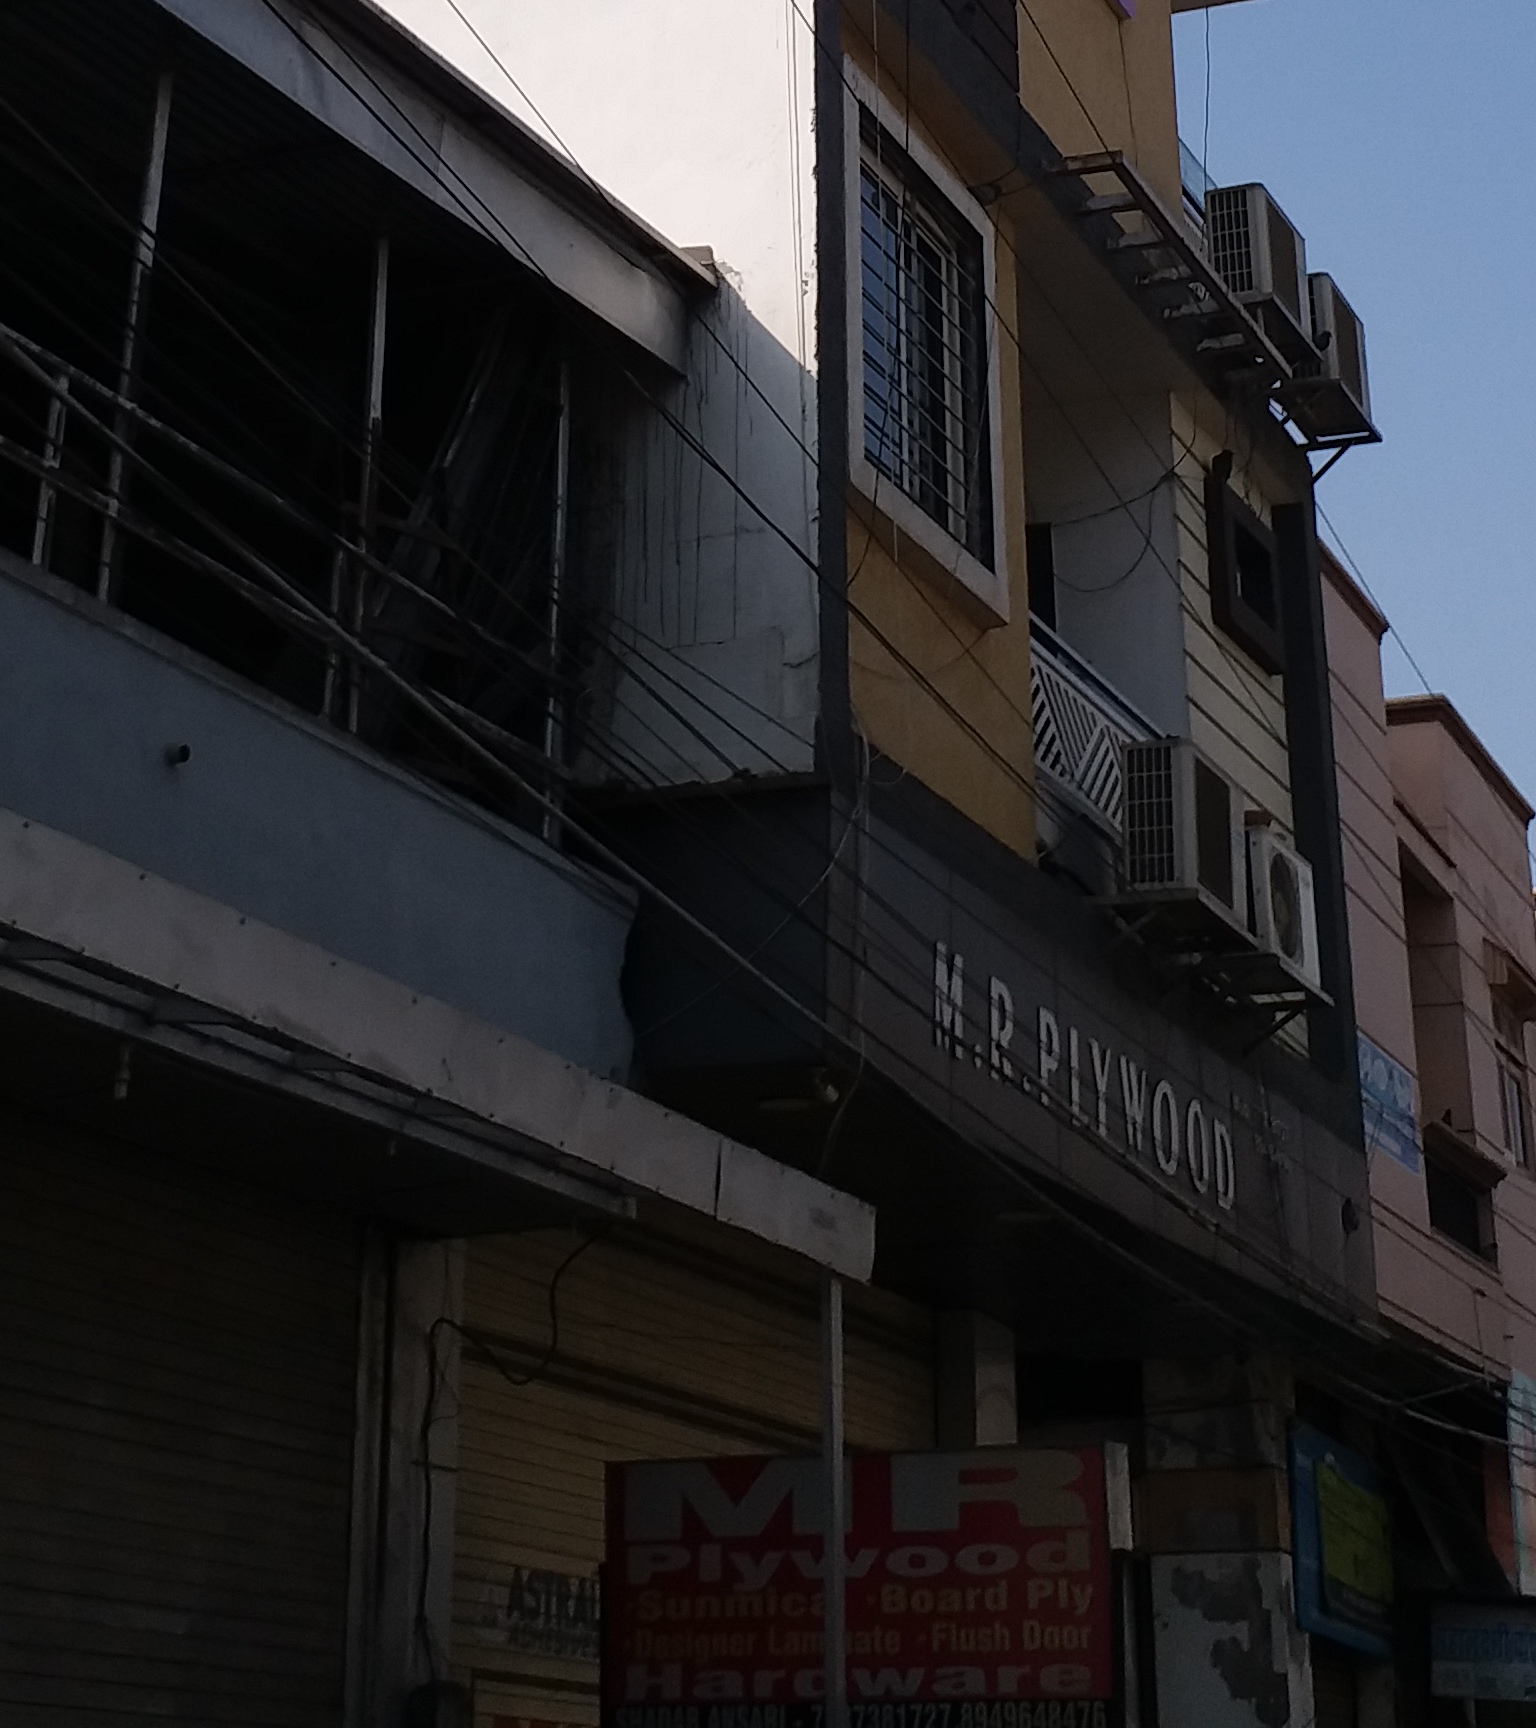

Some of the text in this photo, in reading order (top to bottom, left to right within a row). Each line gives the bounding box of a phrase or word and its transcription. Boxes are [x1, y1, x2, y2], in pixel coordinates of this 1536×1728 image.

[626, 1530, 1091, 1592] Plywood
[881, 1579, 1008, 1614] Board
[1027, 1576, 1093, 1615] Ply
[931, 1621, 1012, 1652] Flush
[1023, 1619, 1091, 1651] Door
